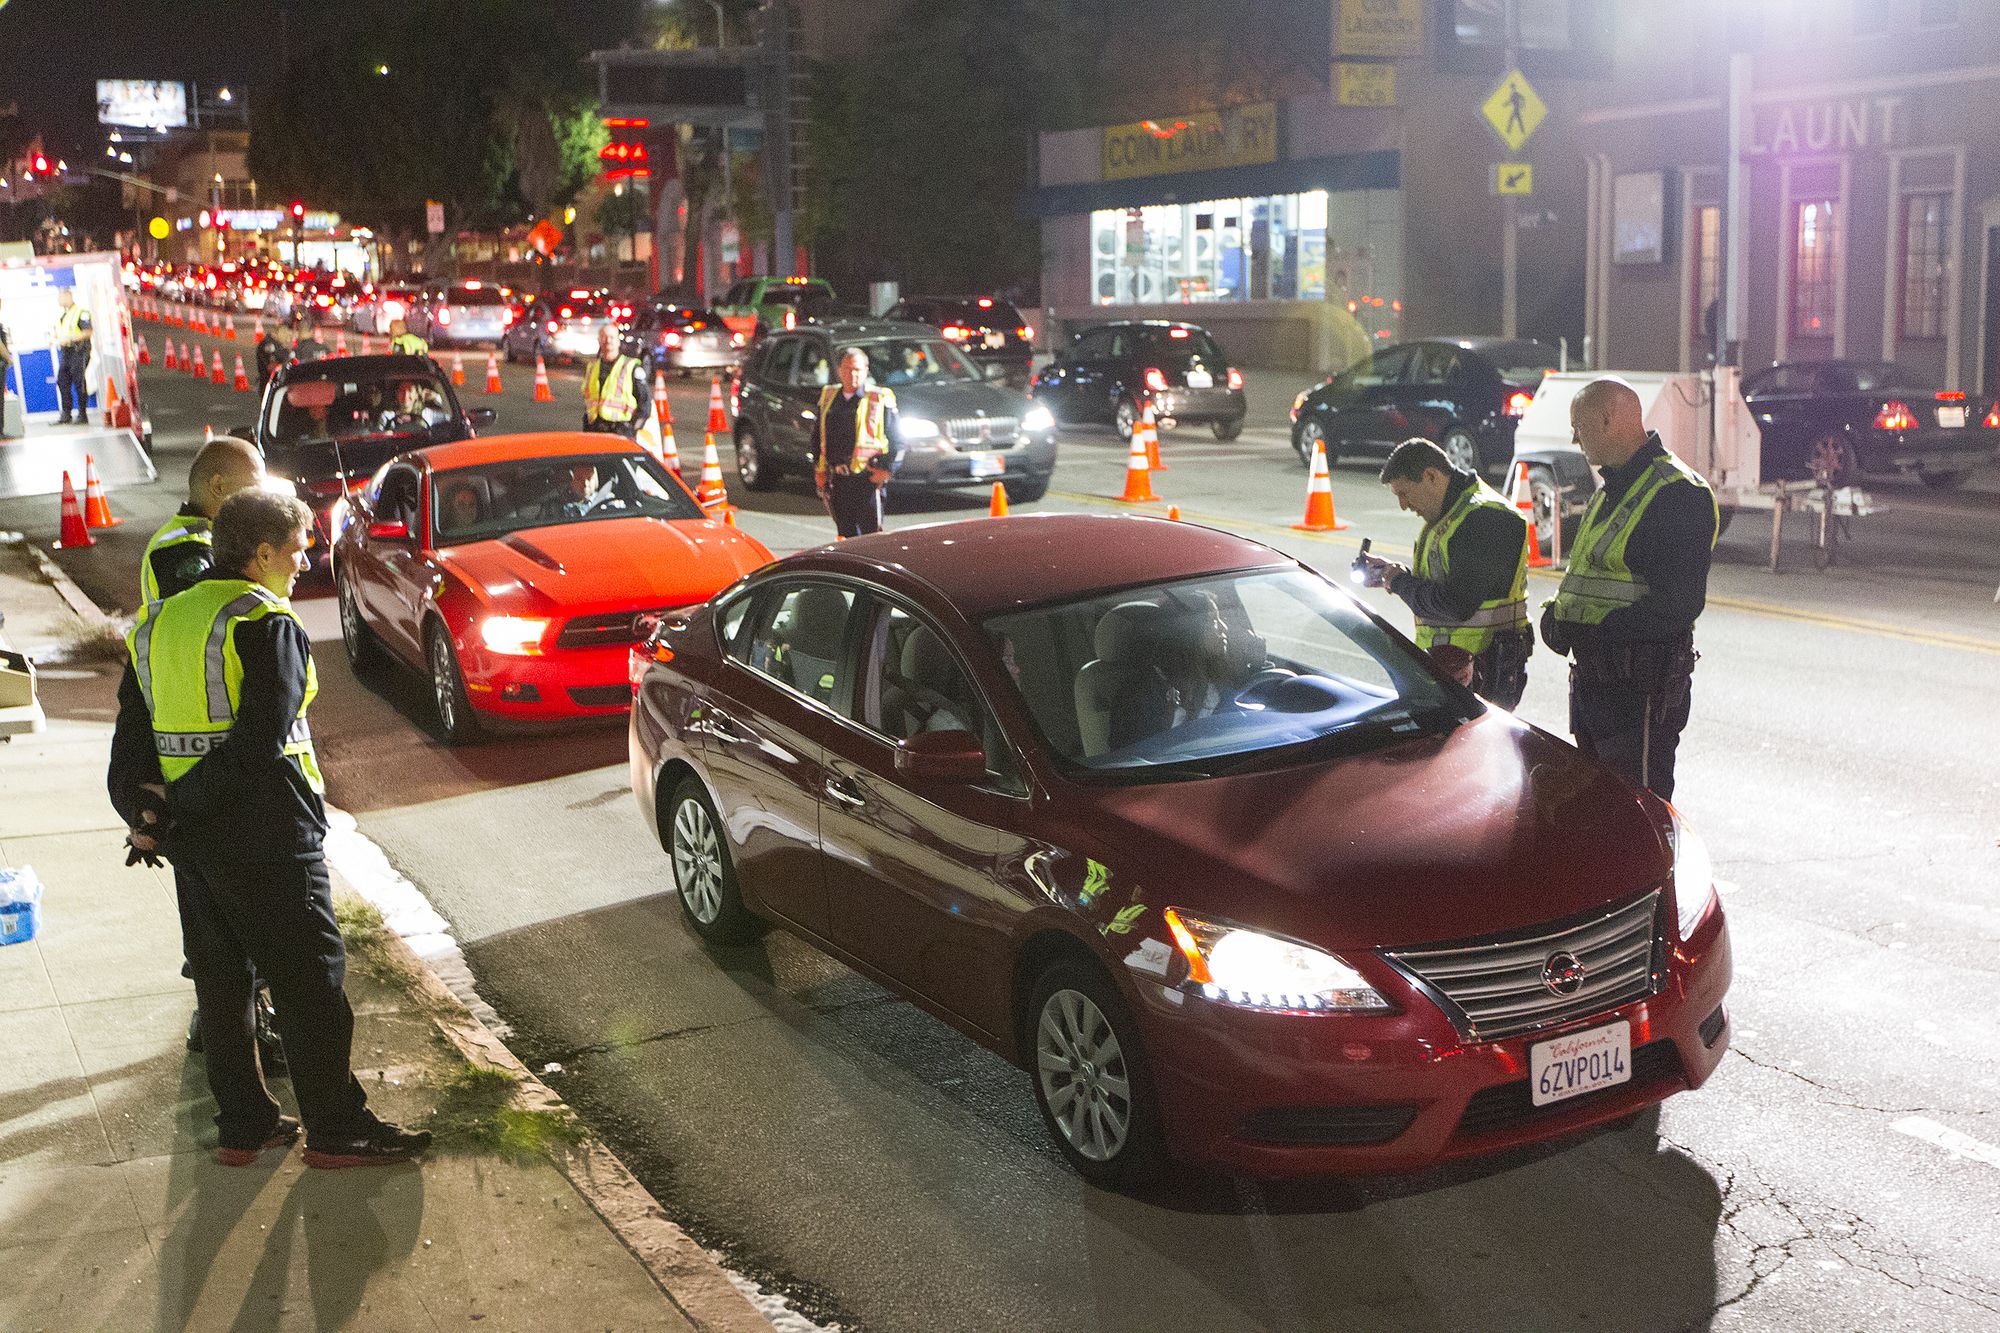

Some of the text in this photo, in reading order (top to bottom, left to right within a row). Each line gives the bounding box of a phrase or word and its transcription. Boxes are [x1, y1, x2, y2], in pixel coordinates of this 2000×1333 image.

[1108, 112, 1274, 167] COIN LAUNRY
[158, 736, 223, 753] OLICE
[1552, 1035, 1612, 1058] California
[1540, 1047, 1624, 1094] 6ZVP014
